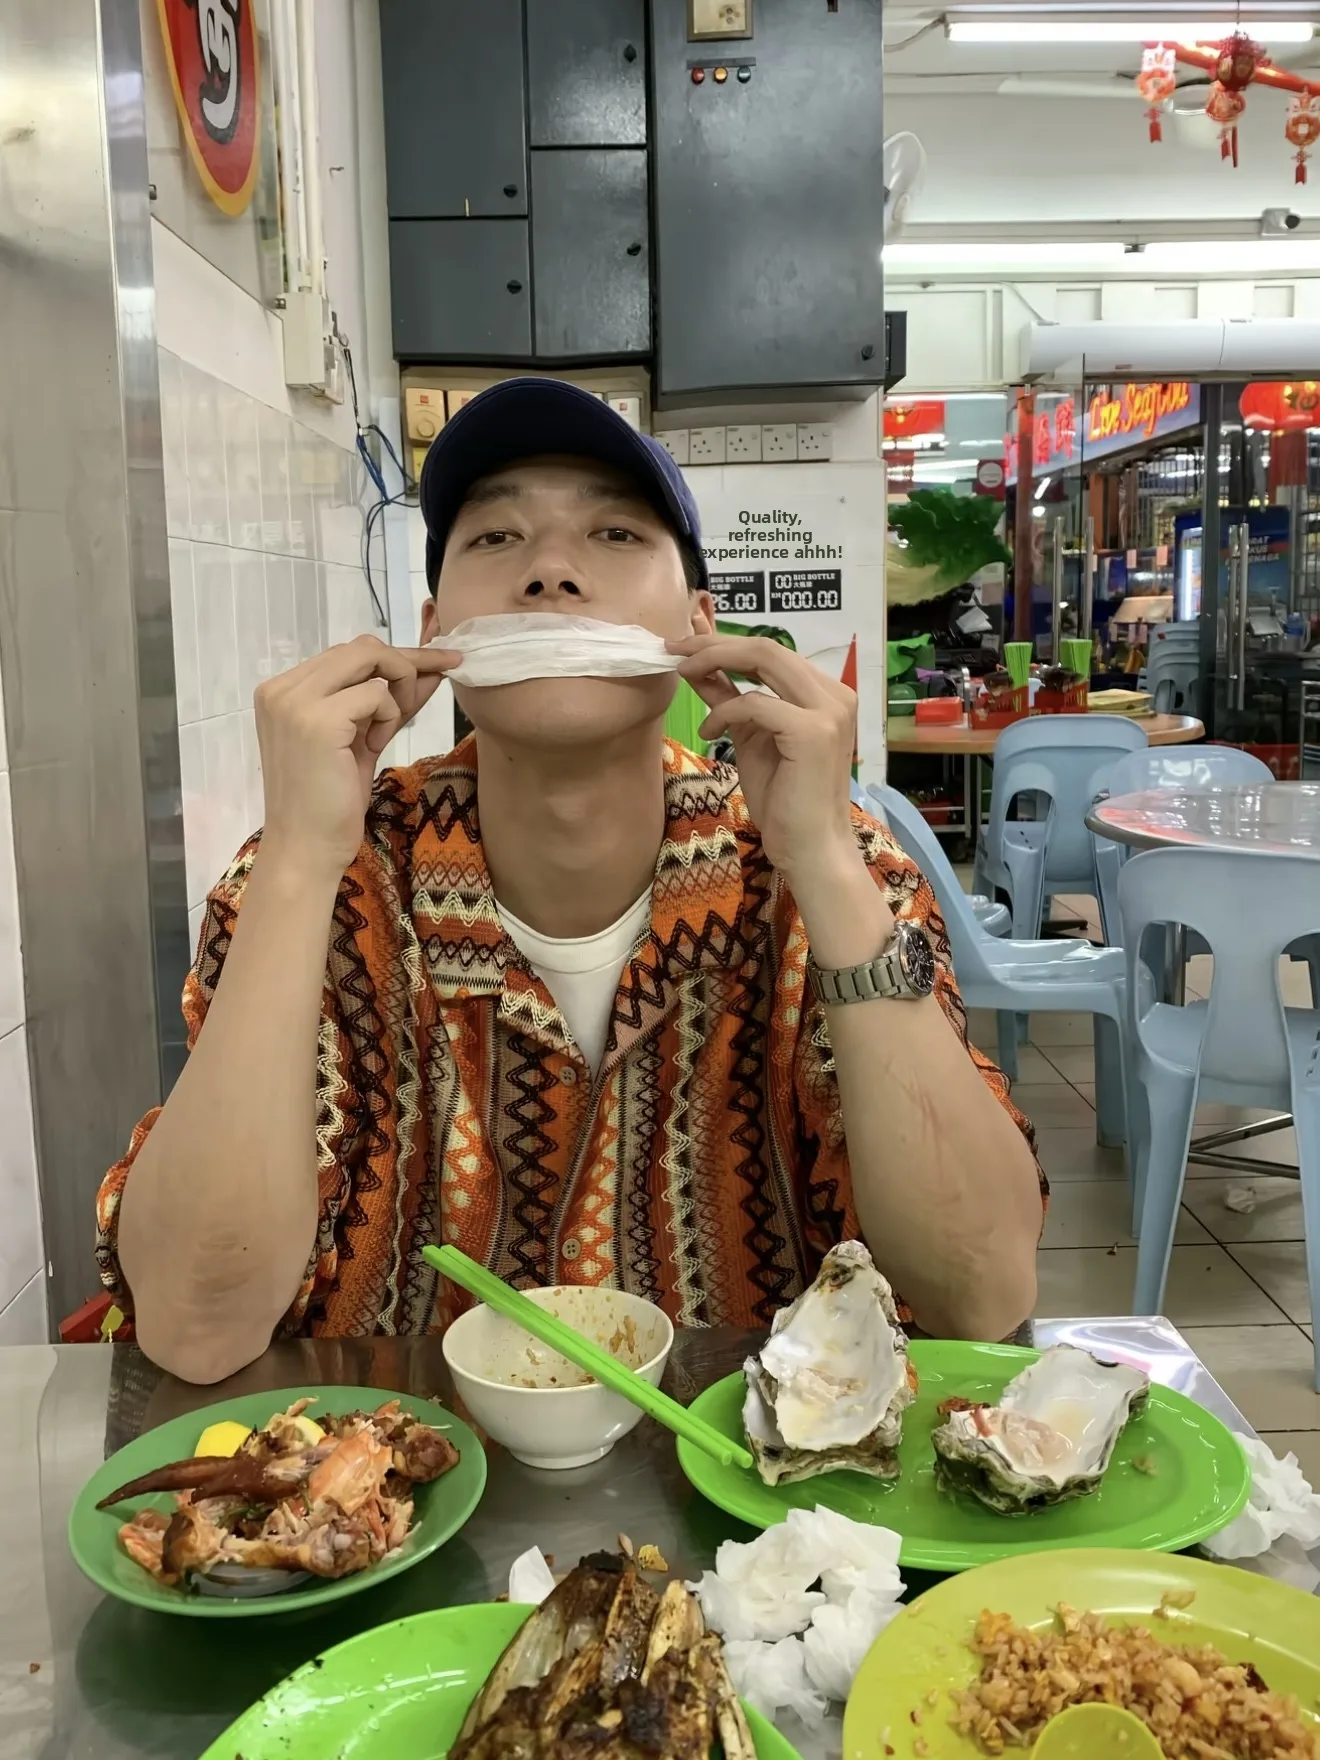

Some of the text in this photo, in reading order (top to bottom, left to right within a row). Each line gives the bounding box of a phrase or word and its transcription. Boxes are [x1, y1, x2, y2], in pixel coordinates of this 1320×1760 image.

[739, 510, 802, 527] Quality,
[728, 528, 812, 544] refreshing
[700, 545, 842, 561] experience ahhh!
[775, 574, 792, 589] 00
